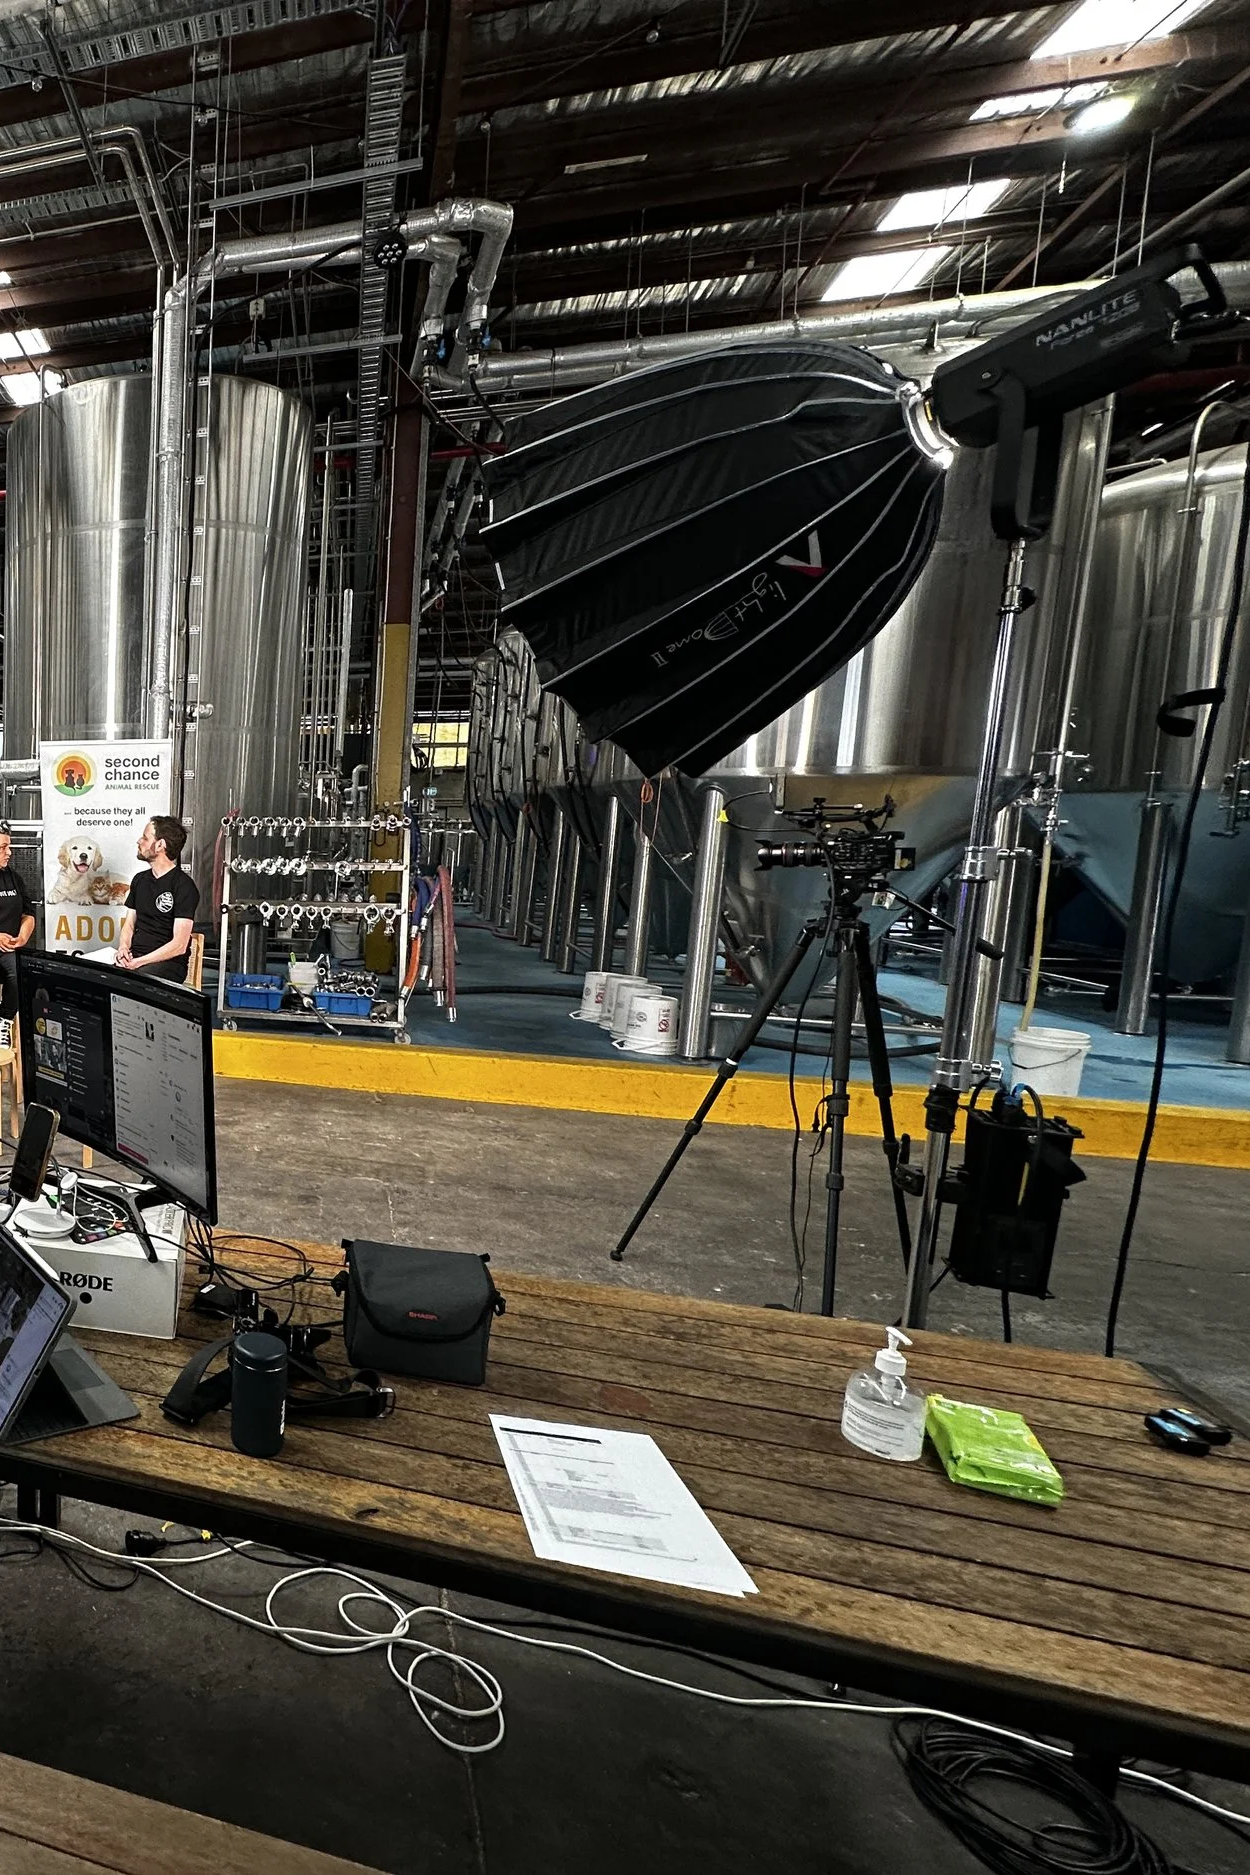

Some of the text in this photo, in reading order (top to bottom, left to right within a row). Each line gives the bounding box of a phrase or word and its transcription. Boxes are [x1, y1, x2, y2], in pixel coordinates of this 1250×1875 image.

[1036, 290, 1137, 348] NANLITE
[105, 754, 160, 768] second
[105, 768, 160, 781] chance
[74, 807, 111, 815] because
[113, 806, 133, 817] they
[135, 806, 146, 815] all
[76, 818, 133, 826] deserve one!
[55, 915, 127, 943] ADO
[59, 1271, 114, 1292] RØDE
